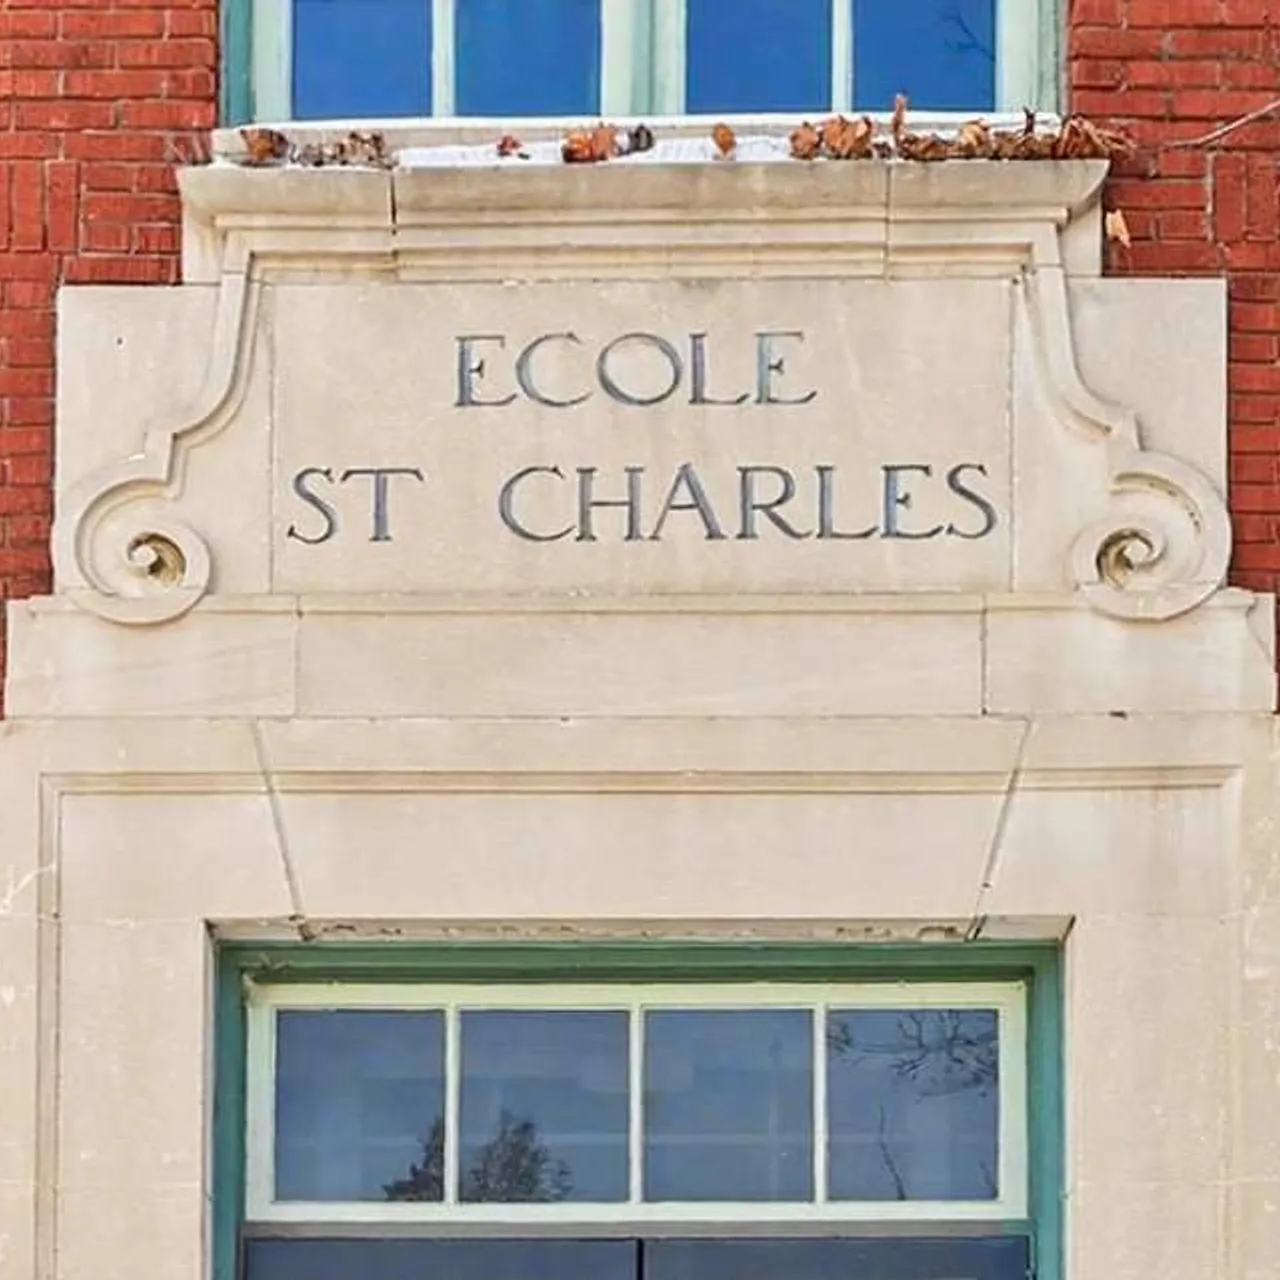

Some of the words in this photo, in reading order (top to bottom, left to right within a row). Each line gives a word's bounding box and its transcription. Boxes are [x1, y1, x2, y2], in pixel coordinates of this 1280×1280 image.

[453, 331, 817, 408] ECOLE
[286, 465, 425, 545] ST
[498, 462, 999, 543] CHARLES
